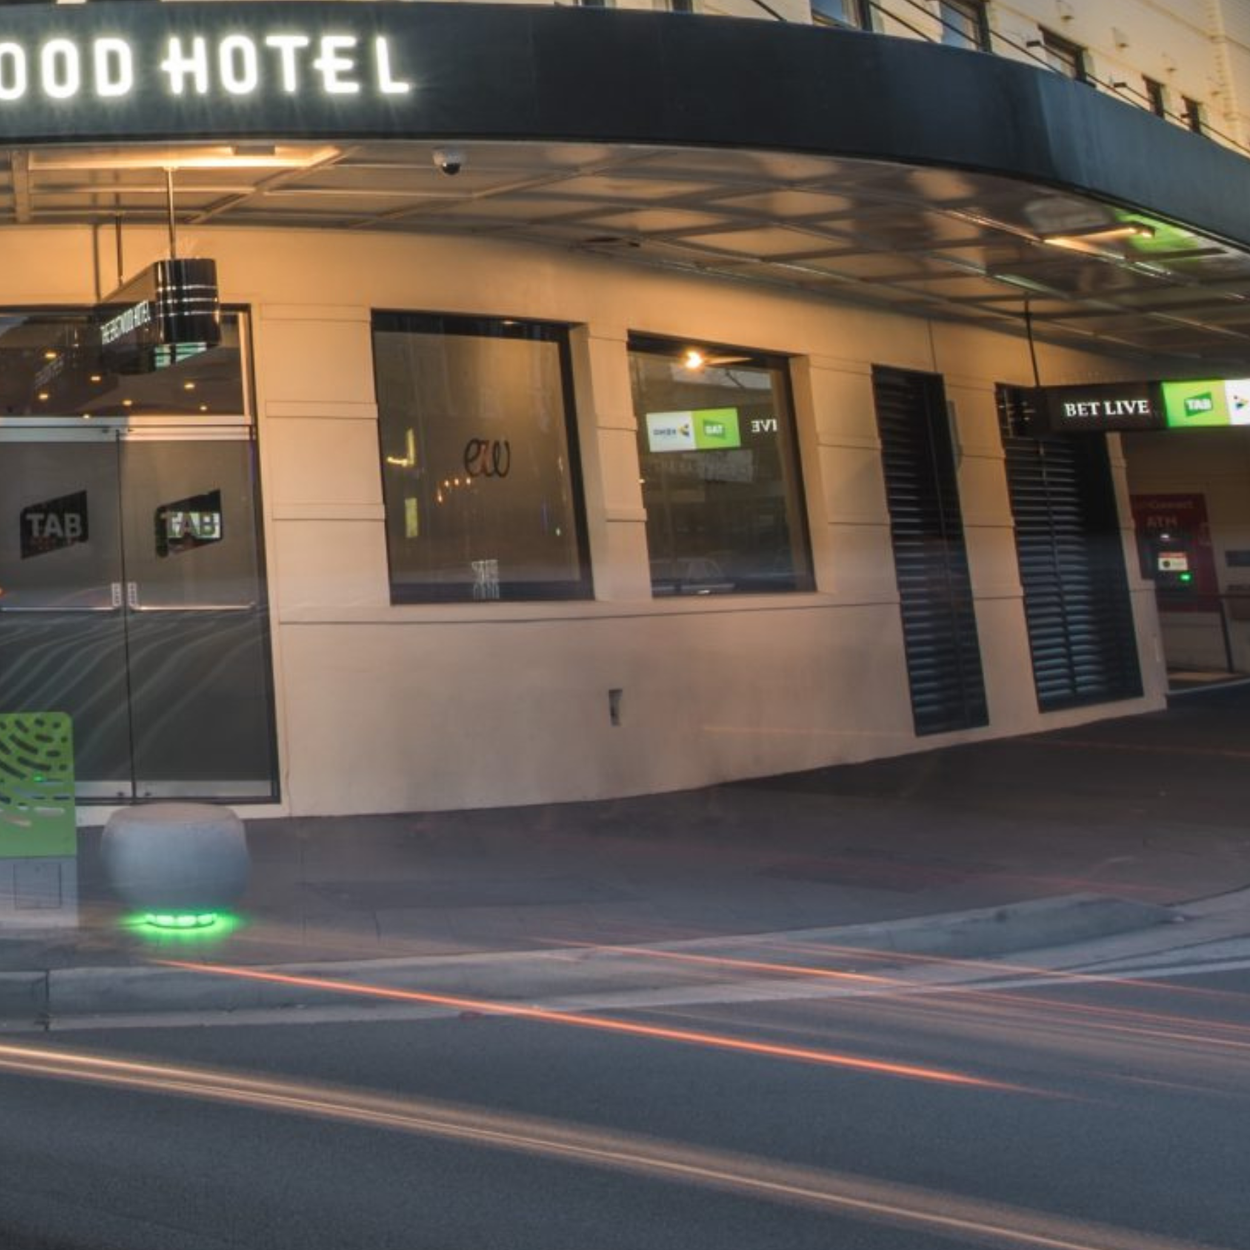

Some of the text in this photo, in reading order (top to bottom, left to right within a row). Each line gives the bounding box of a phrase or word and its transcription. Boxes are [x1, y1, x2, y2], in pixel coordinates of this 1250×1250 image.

[158, 33, 412, 96] HOTEL
[1064, 399, 1150, 417] BET LIVE
[1185, 398, 1213, 411] TAB
[25, 512, 83, 538] TAB
[161, 512, 216, 538] TAB
